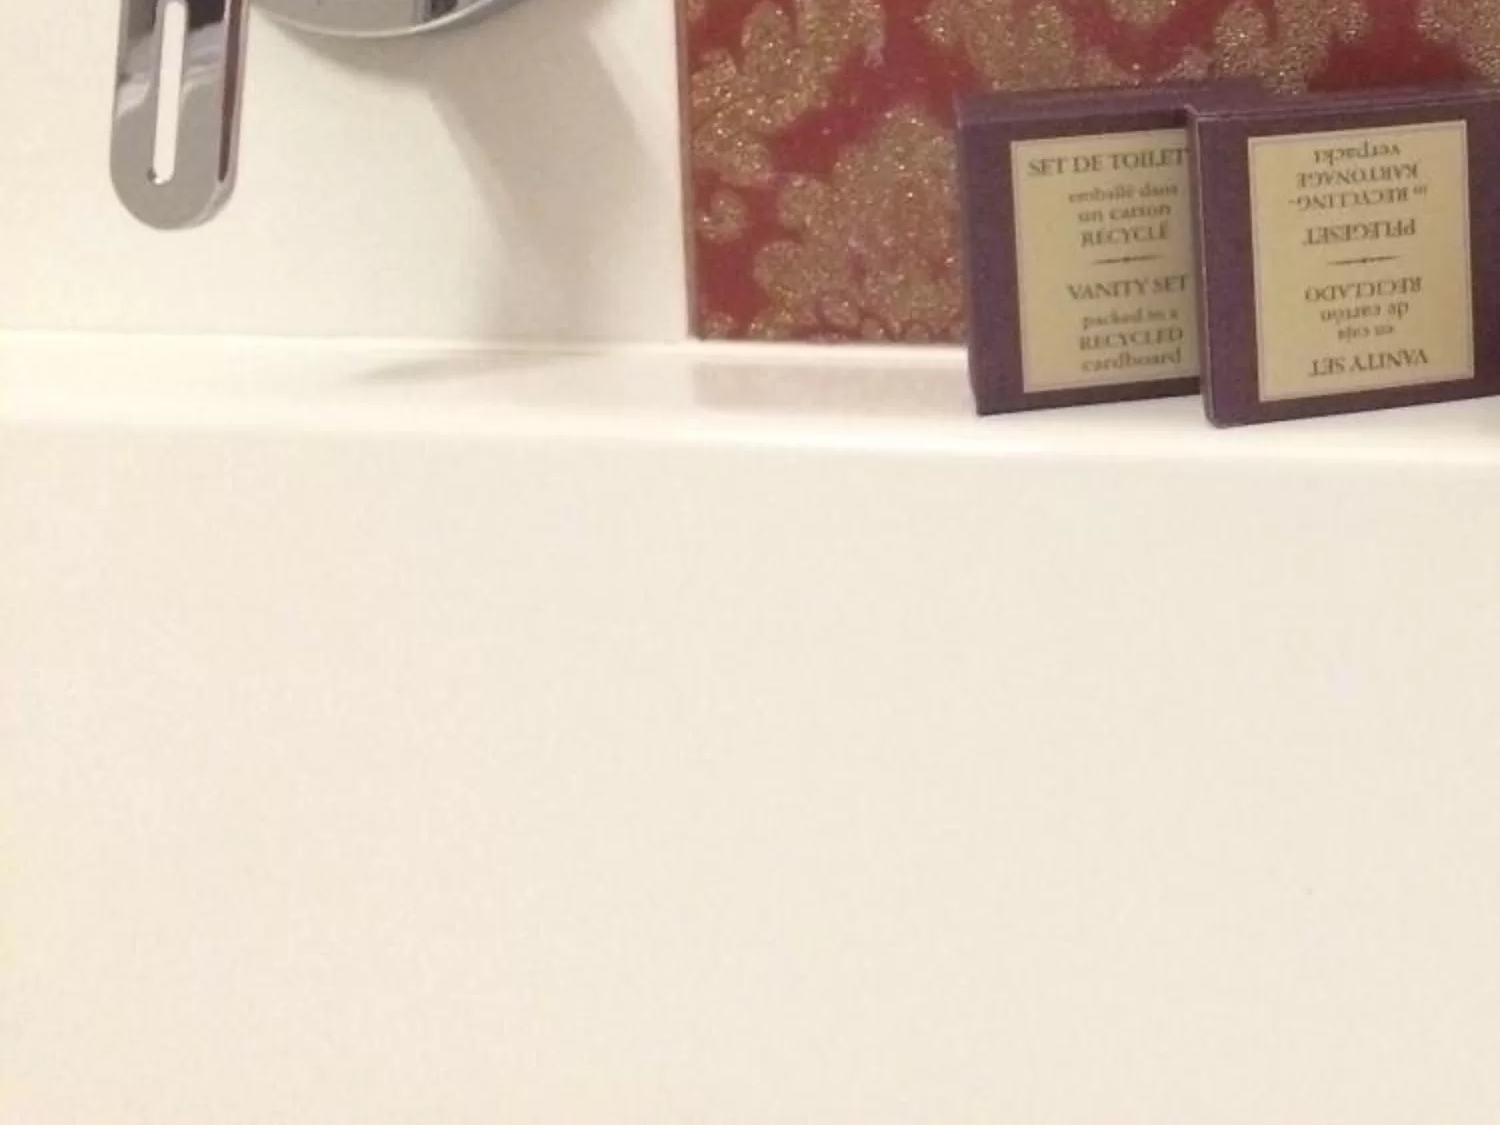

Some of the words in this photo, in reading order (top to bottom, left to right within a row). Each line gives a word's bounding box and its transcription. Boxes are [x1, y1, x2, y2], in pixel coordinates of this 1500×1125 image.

[1027, 155, 1069, 176] SET
[1073, 153, 1104, 174] DE
[1297, 162, 1418, 188] KARTONAGE
[1137, 181, 1178, 198] dans
[1078, 208, 1103, 223] un
[1109, 203, 1171, 221] carton
[1066, 277, 1148, 300] VANITY
[1152, 274, 1188, 294] SET
[1304, 276, 1423, 303] RECICLADO
[1083, 306, 1143, 331] packed
[1079, 326, 1183, 351] RECYCLED
[1082, 347, 1182, 372] cardboard
[1308, 355, 1347, 378] SET
[1350, 347, 1429, 374] VANITY
